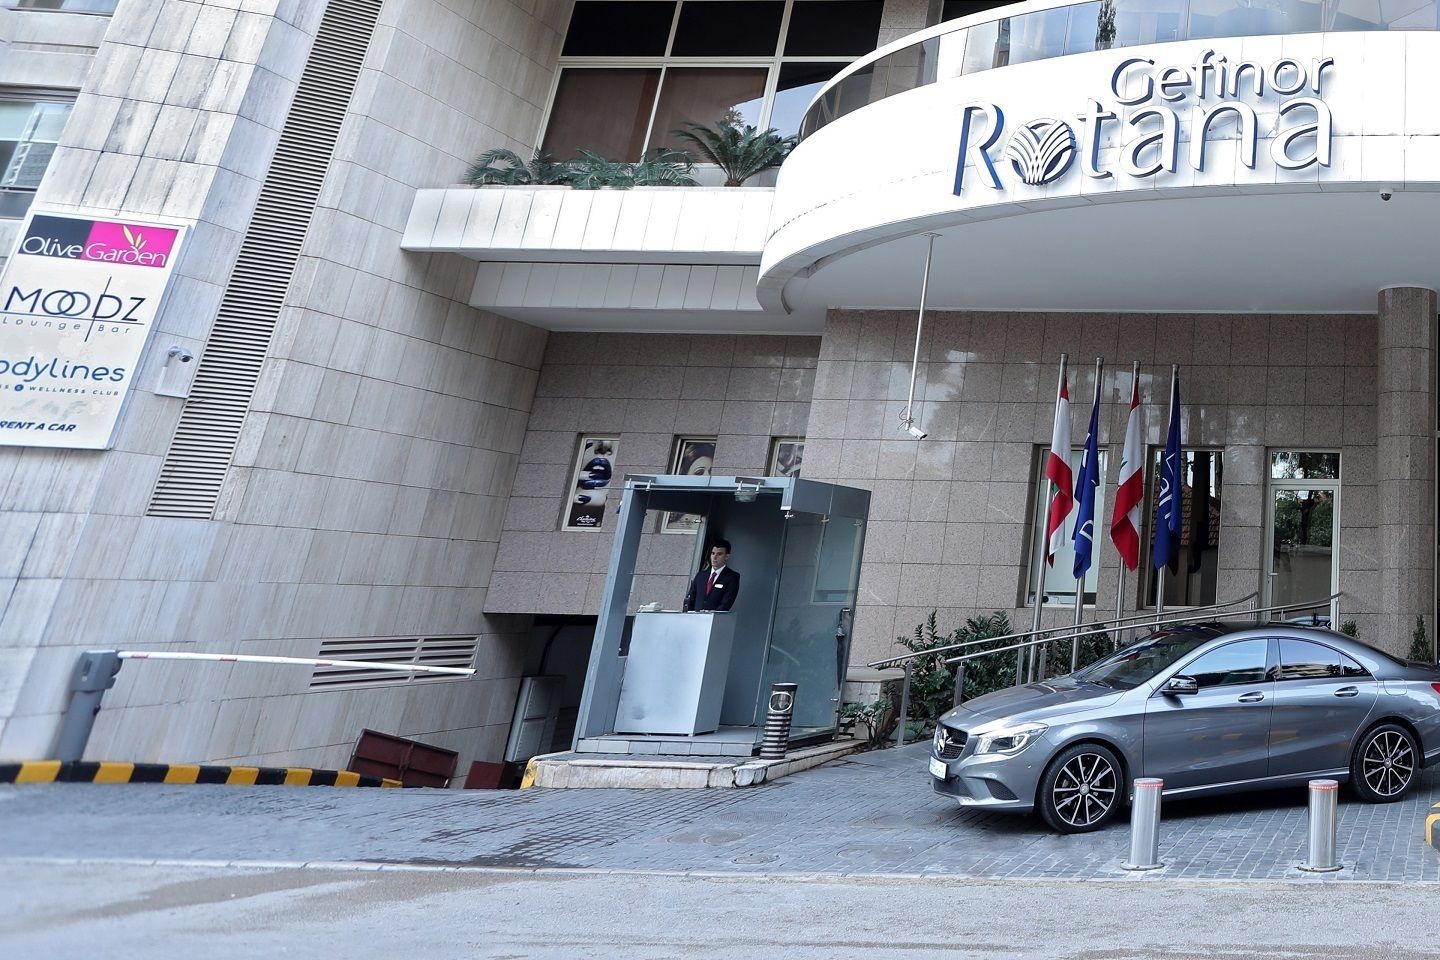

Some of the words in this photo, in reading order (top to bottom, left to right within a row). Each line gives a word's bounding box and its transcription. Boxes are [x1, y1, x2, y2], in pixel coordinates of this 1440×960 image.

[1110, 48, 1335, 105] Gefinor
[952, 96, 1334, 197] Rotana
[22, 236, 83, 258] Olive
[85, 242, 167, 267] Garden
[3, 285, 146, 322] MOODZ
[1, 315, 81, 331] Lounge
[97, 323, 132, 334] Bar
[29, 385, 86, 395] WELLNESS
[92, 389, 119, 397] CLUB
[35, 422, 46, 431] A
[47, 423, 77, 432] CAR
